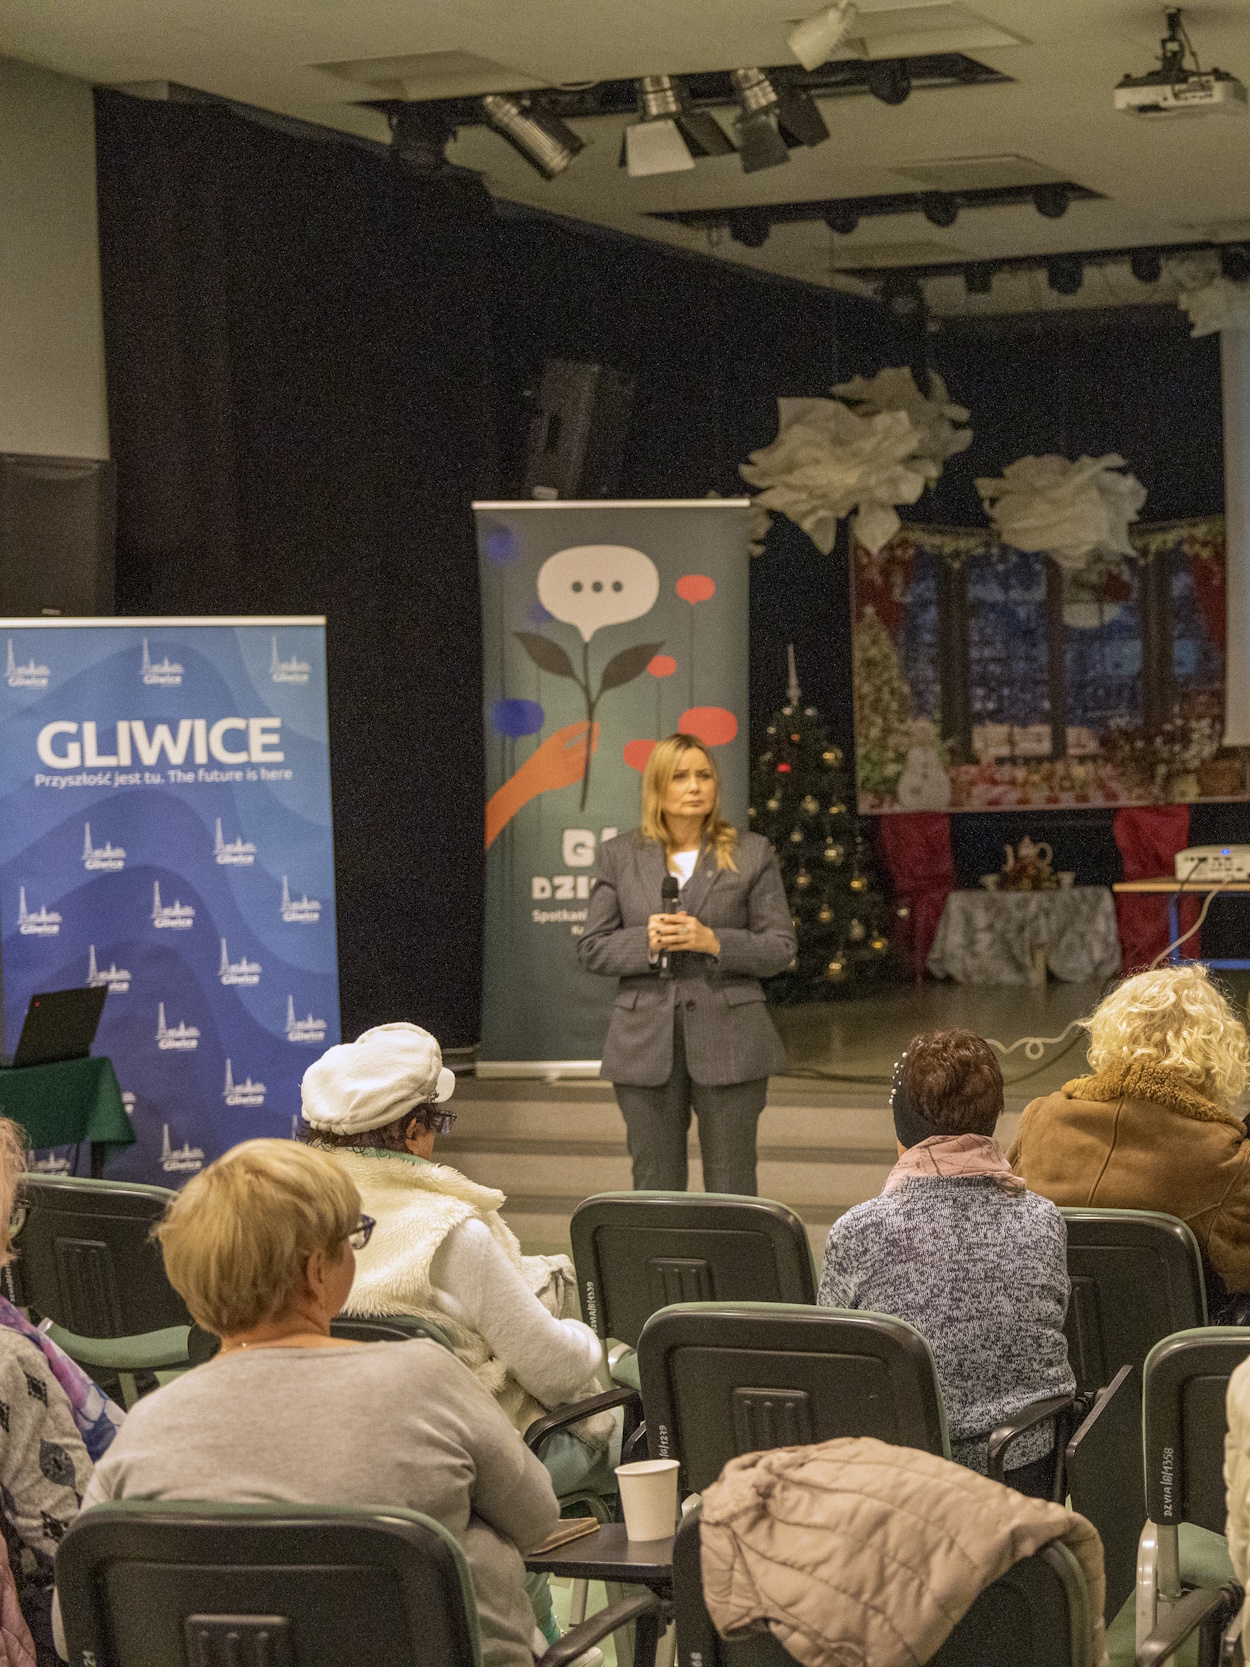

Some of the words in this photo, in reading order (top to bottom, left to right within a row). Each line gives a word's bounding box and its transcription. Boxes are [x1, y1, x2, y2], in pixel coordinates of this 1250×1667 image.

[36, 717, 285, 769] GLIWICE
[34, 772, 111, 789] Przyszłość
[113, 771, 141, 787] jest
[144, 771, 165, 785] tu.
[167, 769, 195, 784] The
[198, 768, 243, 783] future
[246, 768, 258, 782] is
[260, 767, 293, 781] here
